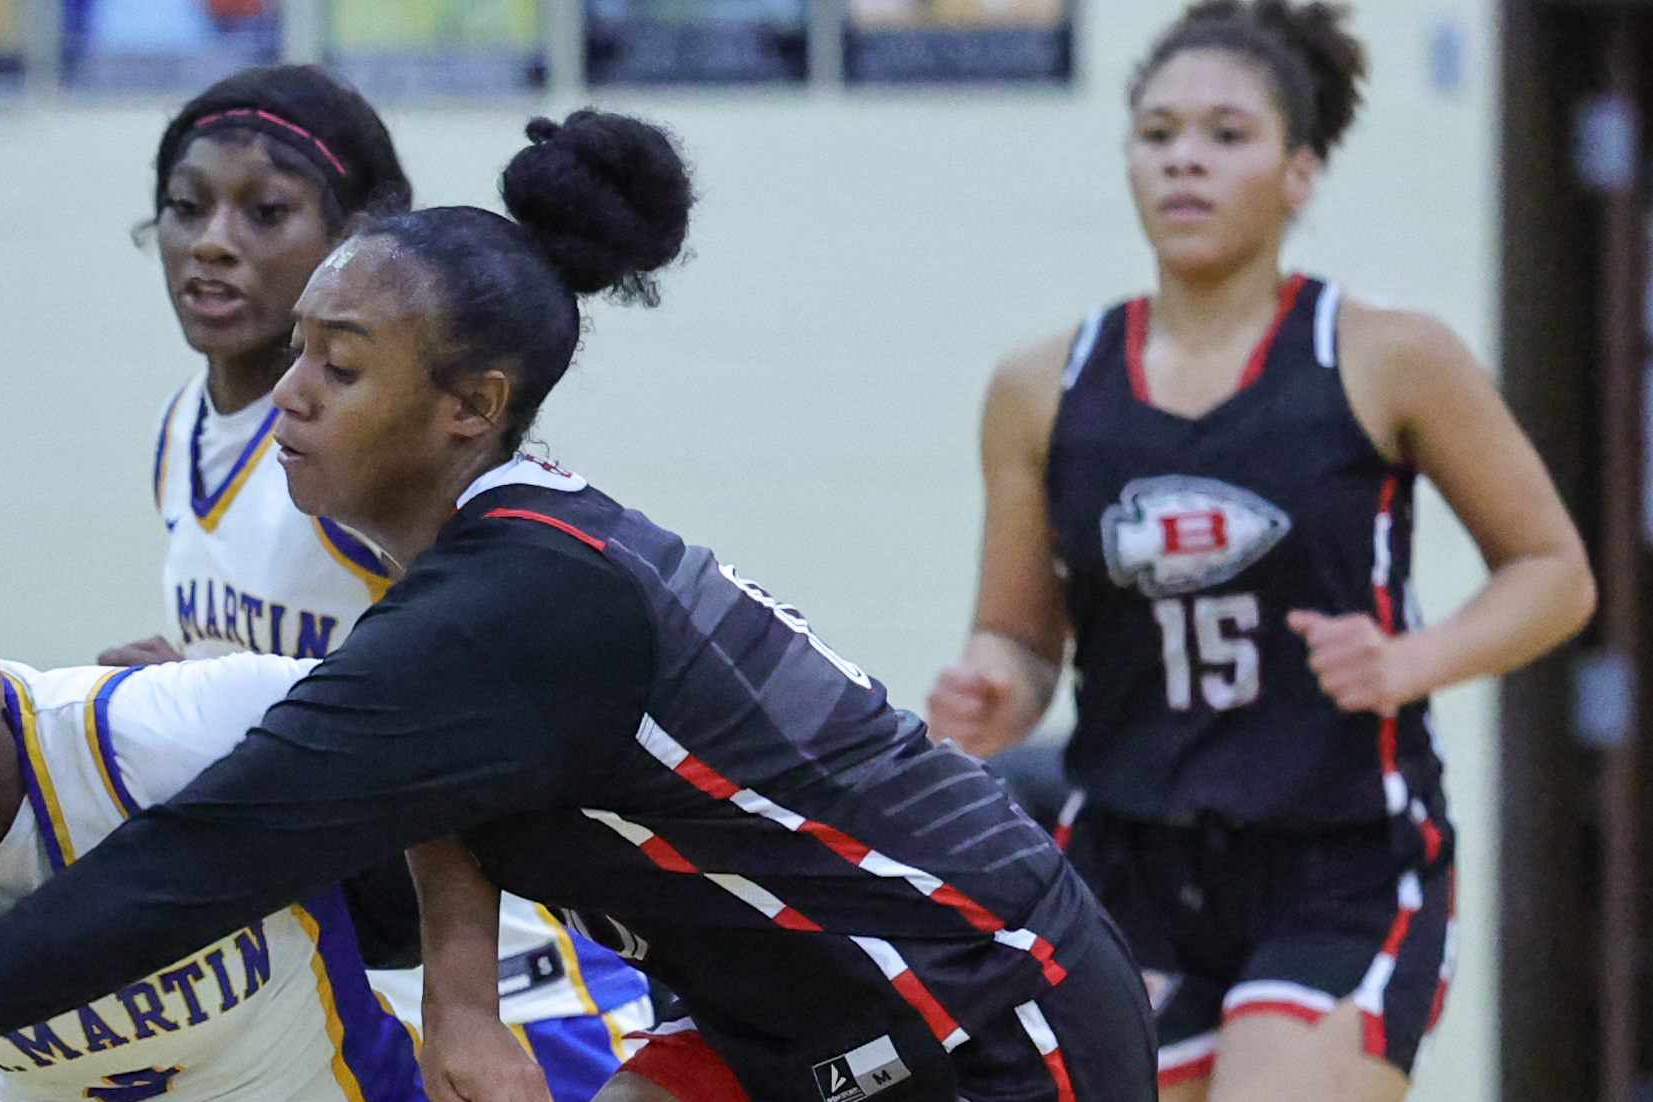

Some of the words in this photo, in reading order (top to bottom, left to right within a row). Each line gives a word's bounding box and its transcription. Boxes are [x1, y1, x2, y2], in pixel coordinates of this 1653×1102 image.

[175, 577, 340, 659] MARTIN
[1153, 593, 1260, 711] 15
[871, 1069, 892, 1085] M
